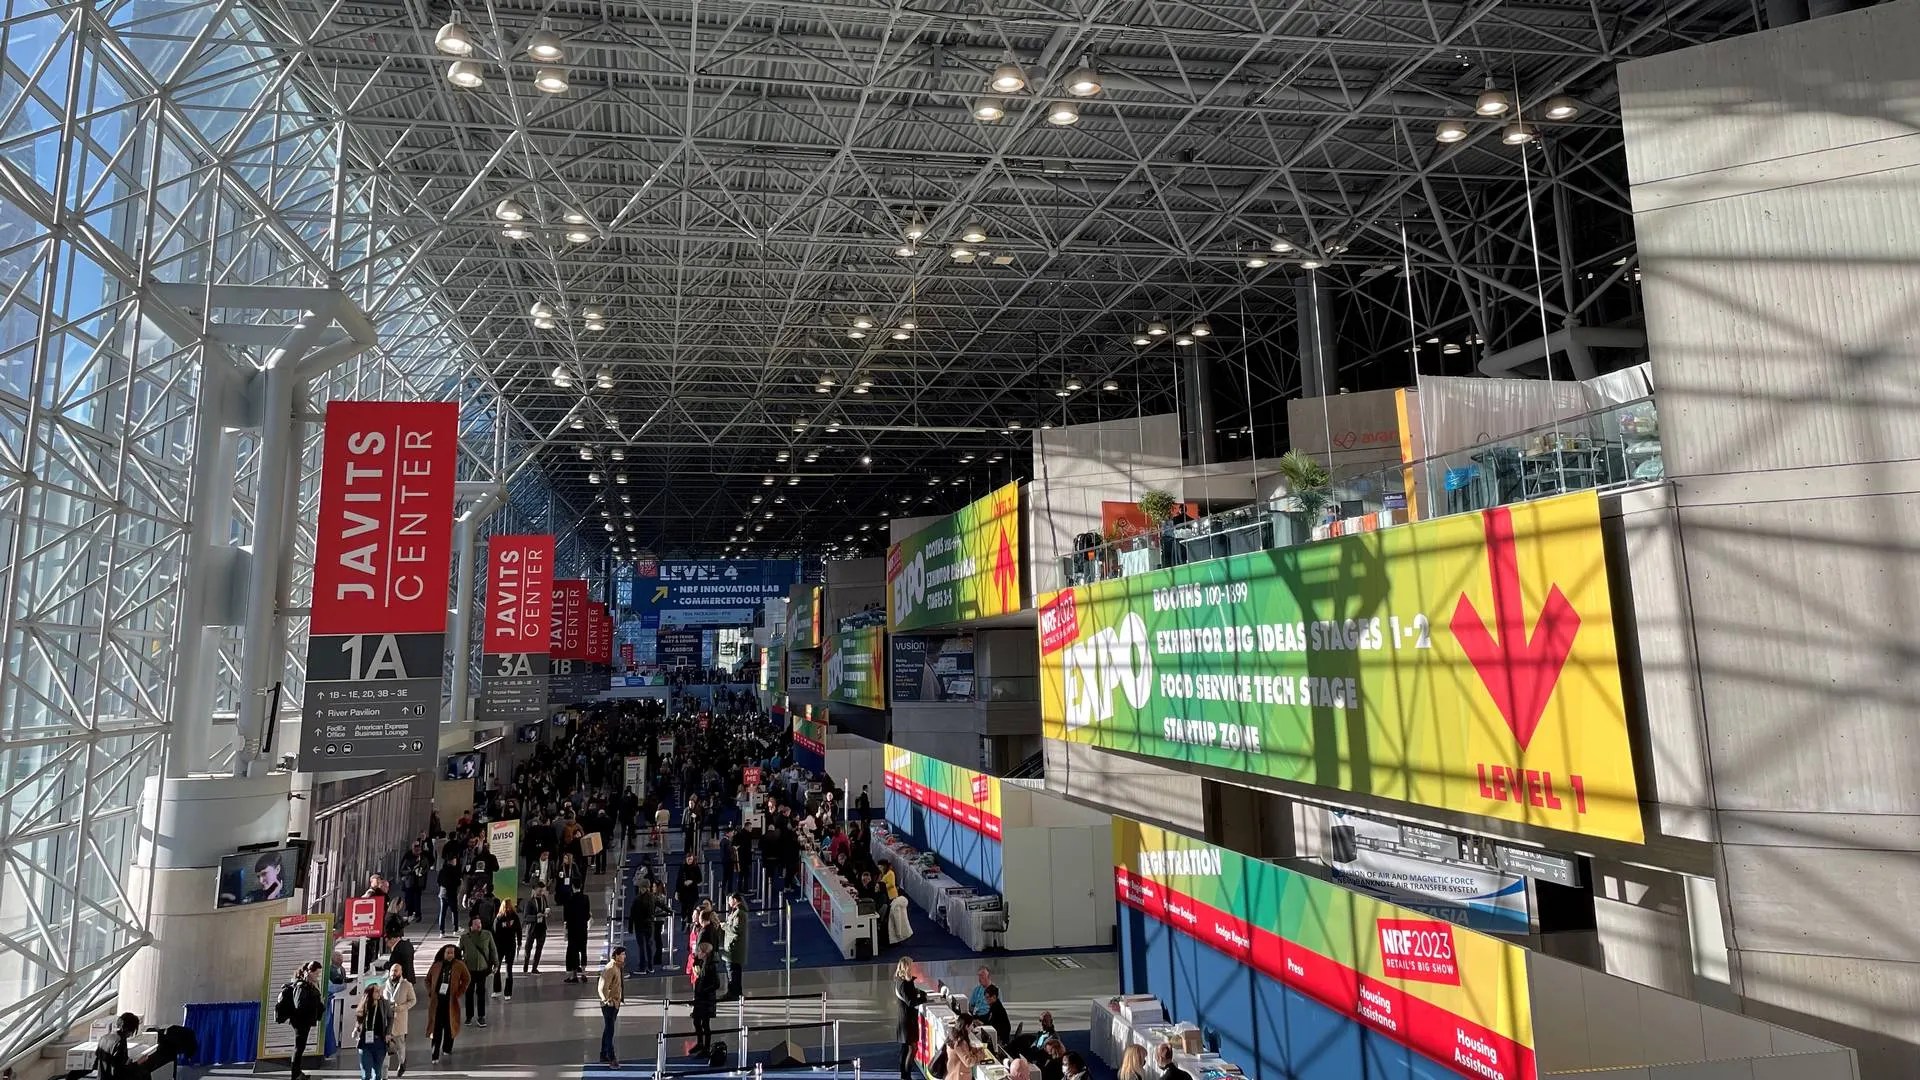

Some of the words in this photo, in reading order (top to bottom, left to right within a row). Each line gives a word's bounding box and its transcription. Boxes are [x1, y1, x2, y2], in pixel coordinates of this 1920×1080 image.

[337, 431, 386, 600] JAVITS
[395, 431, 433, 601] CENTER
[659, 565, 720, 581] LEVEL
[724, 565, 739, 581] 4
[496, 550, 520, 637] JAVITS
[524, 549, 543, 637] CENTER
[679, 585, 698, 594] NRF
[700, 585, 760, 594] INNOVATION
[762, 585, 780, 593] LAB
[679, 596, 760, 606] COMMERCETOOLS
[894, 551, 926, 627] EXPO
[927, 590, 943, 611] STAGES
[1153, 583, 1201, 612] BOOTHS
[1204, 583, 1248, 606] 100-1899
[550, 590, 564, 648] JAVITS
[567, 589, 580, 649] CENTER
[589, 608, 599, 654] CENTER
[1156, 628, 1224, 654] EXHIBITOR
[1225, 625, 1254, 652] BIG
[1256, 622, 1307, 652] IDEAS
[1310, 617, 1382, 651] STAGES
[1389, 613, 1433, 649] 1-2
[601, 622, 609, 658] CENTER
[896, 640, 925, 650] vusion
[341, 634, 408, 681] 1A
[497, 653, 534, 677] 3A
[551, 659, 572, 675] 1B
[1063, 611, 1153, 732] EXPO
[329, 691, 340, 699] 1B
[349, 690, 360, 699] 1E,
[362, 690, 375, 699] 2D,
[377, 689, 389, 698] 3B
[397, 689, 408, 697] 3E
[1160, 673, 1194, 699] FOOD
[1195, 674, 1252, 702] SERVICE
[1253, 675, 1296, 705] TECH
[1299, 676, 1358, 709] STAGE
[327, 709, 348, 717] River
[350, 708, 380, 717] Pavilion
[384, 723, 409, 731] Express
[384, 729, 409, 737] Lounge
[1163, 717, 1217, 746] STARTUP
[1218, 722, 1261, 753] ZONE
[1477, 763, 1561, 810] LEVEL
[1569, 775, 1587, 814] 1
[492, 831, 514, 841] AVISO
[1139, 848, 1222, 876] REGISTRATION
[1354, 879, 1395, 889] BANKNOTE
[1395, 880, 1409, 890] AIR
[1410, 881, 1447, 893] TRANSFER
[1448, 886, 1479, 894] SYSTEM
[1366, 871, 1376, 879] OF
[1378, 872, 1391, 880] AIR
[1391, 873, 1408, 882] AND
[1409, 874, 1449, 884] MAGNETIC
[1450, 876, 1475, 886] FORCE
[1382, 928, 1451, 960] NRF2023
[1287, 957, 1304, 977] Press
[1386, 958, 1416, 971] RETAIL'S
[1417, 962, 1431, 972] BIG
[1432, 964, 1454, 974] SHOW
[1359, 984, 1391, 1014] Housing
[1357, 1001, 1397, 1031] Assistance
[1456, 1027, 1498, 1065] Housing
[1454, 1047, 1504, 1080] Assistance
